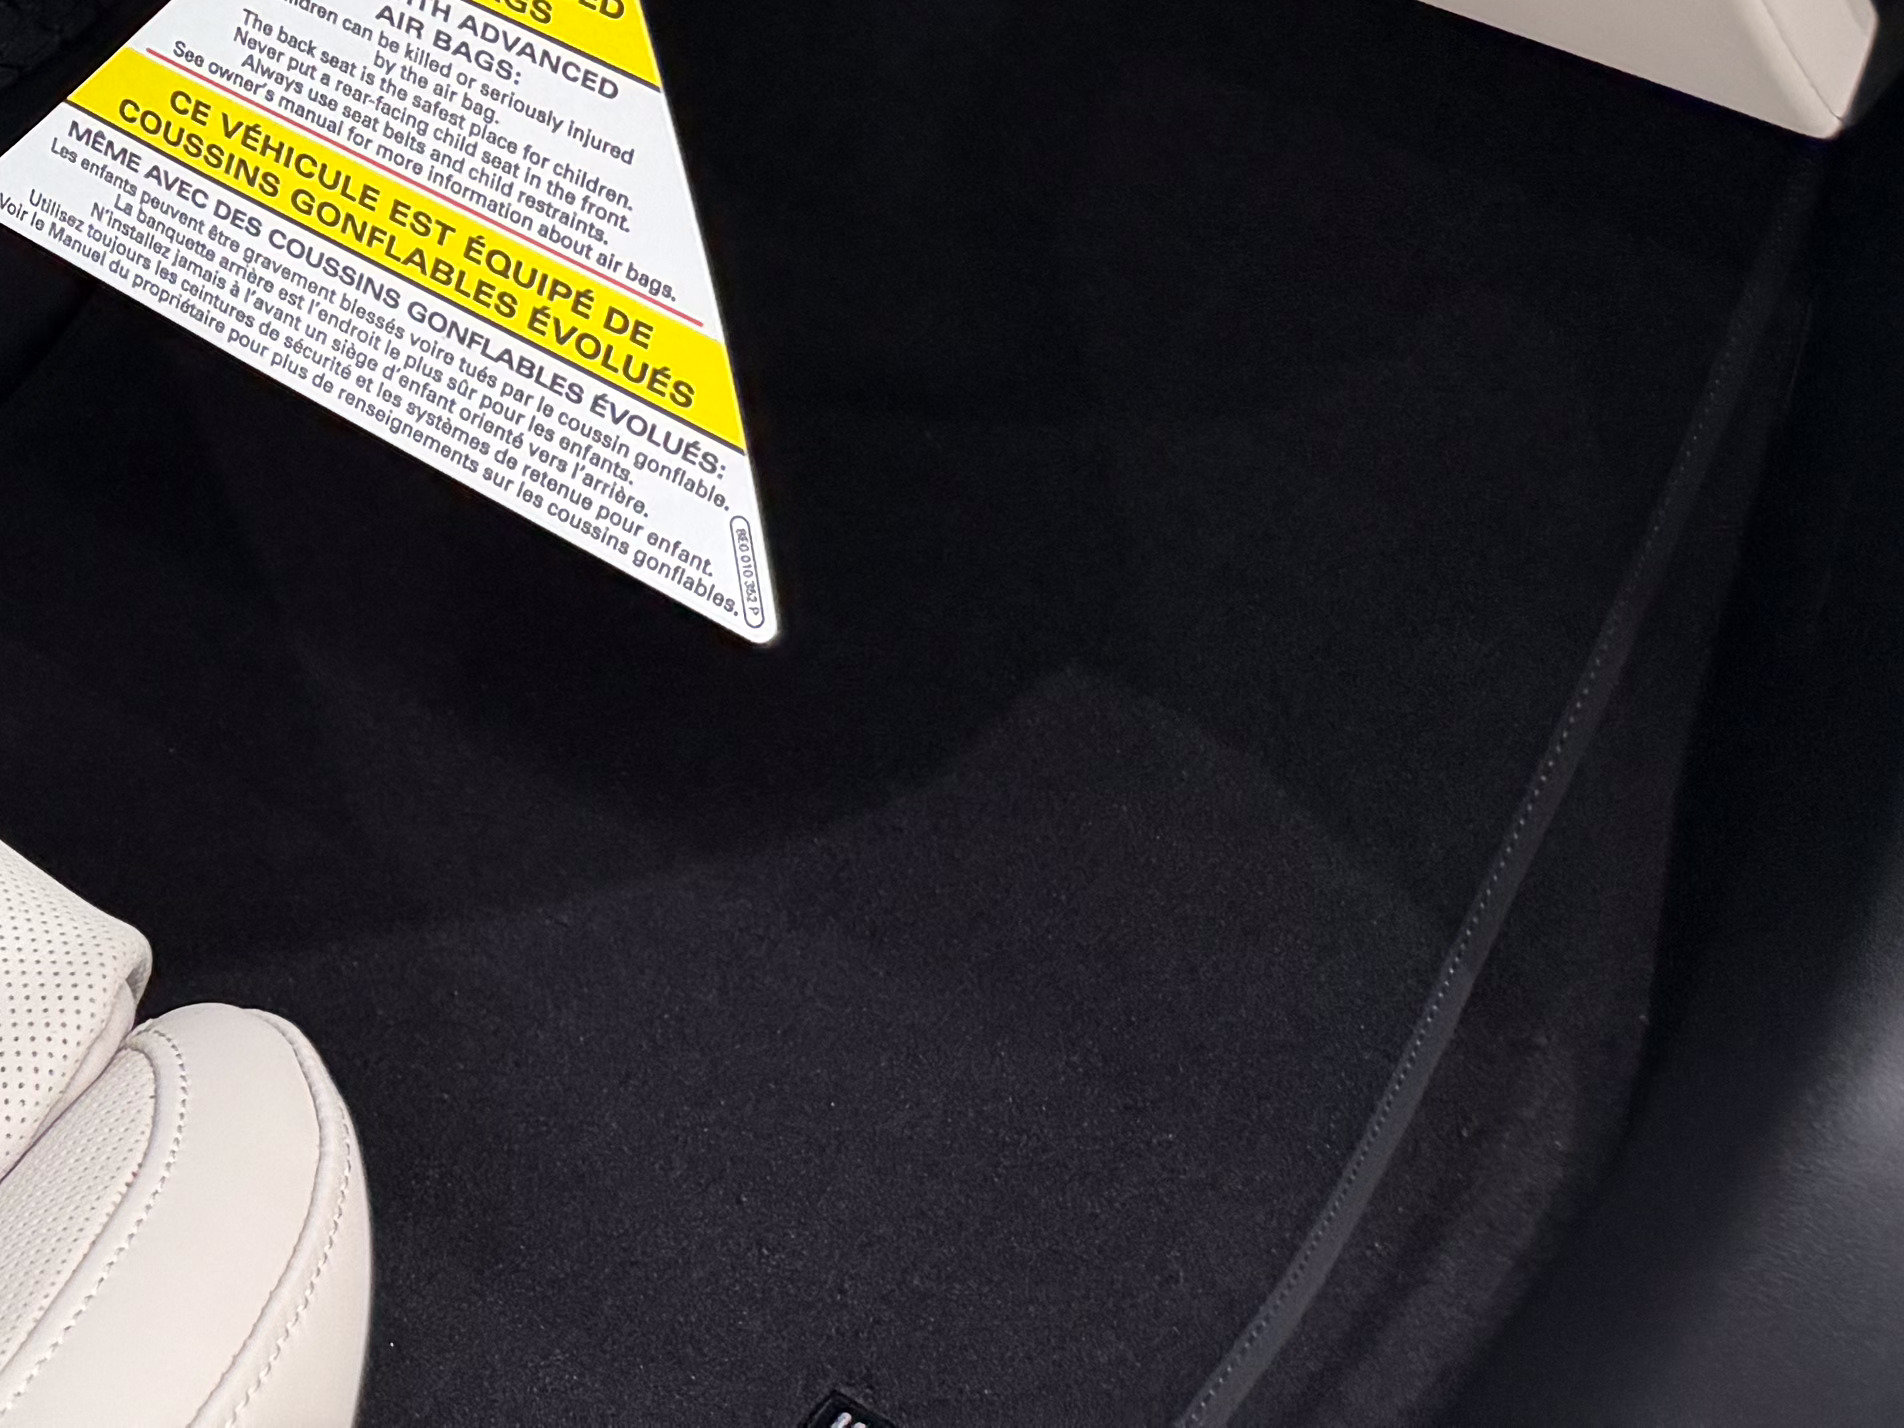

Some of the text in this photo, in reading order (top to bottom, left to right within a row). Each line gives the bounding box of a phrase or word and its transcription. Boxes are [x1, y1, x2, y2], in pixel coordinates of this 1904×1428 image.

[232, 25, 631, 234] Never put a rear-facing child seat in the front.
[242, 7, 634, 212] The back seat is the safest place for children.
[341, 17, 374, 42] can
[376, 29, 401, 54] be
[403, 41, 454, 79] killed
[455, 71, 478, 90] or
[479, 82, 565, 134] seriously
[566, 119, 636, 166] injured
[372, 49, 500, 125] by the air bag.
[374, 4, 522, 86] AIR BAGS:
[456, 13, 620, 100] ADVANCED
[169, 89, 655, 351] CE VÉHICULE EST ÉQUIPÉ DE
[172, 39, 206, 69] See
[277, 94, 345, 137] manual
[346, 125, 374, 151] for
[374, 143, 424, 176] more
[426, 164, 534, 232] information
[536, 223, 594, 261] about
[595, 251, 624, 274] air
[624, 261, 677, 303] bags.
[240, 53, 609, 246] Always use seat belts and child restraints.
[50, 136, 730, 512] Les enfants peuvent être gravement blessés voire tués par le coussin gonflable.
[67, 119, 727, 481] MÊME AVEC DES COUSSINS GONFLABLES ÉVOLUÉS:
[118, 98, 696, 409] COUSSINS GONFLABLES ÉVOLUÉS
[0, 191, 739, 618] Voir le Manuel du propriétaire pour plus de renseignements sur les coussins gonflables.
[740, 554, 754, 578] 010
[748, 606, 760, 616] P
